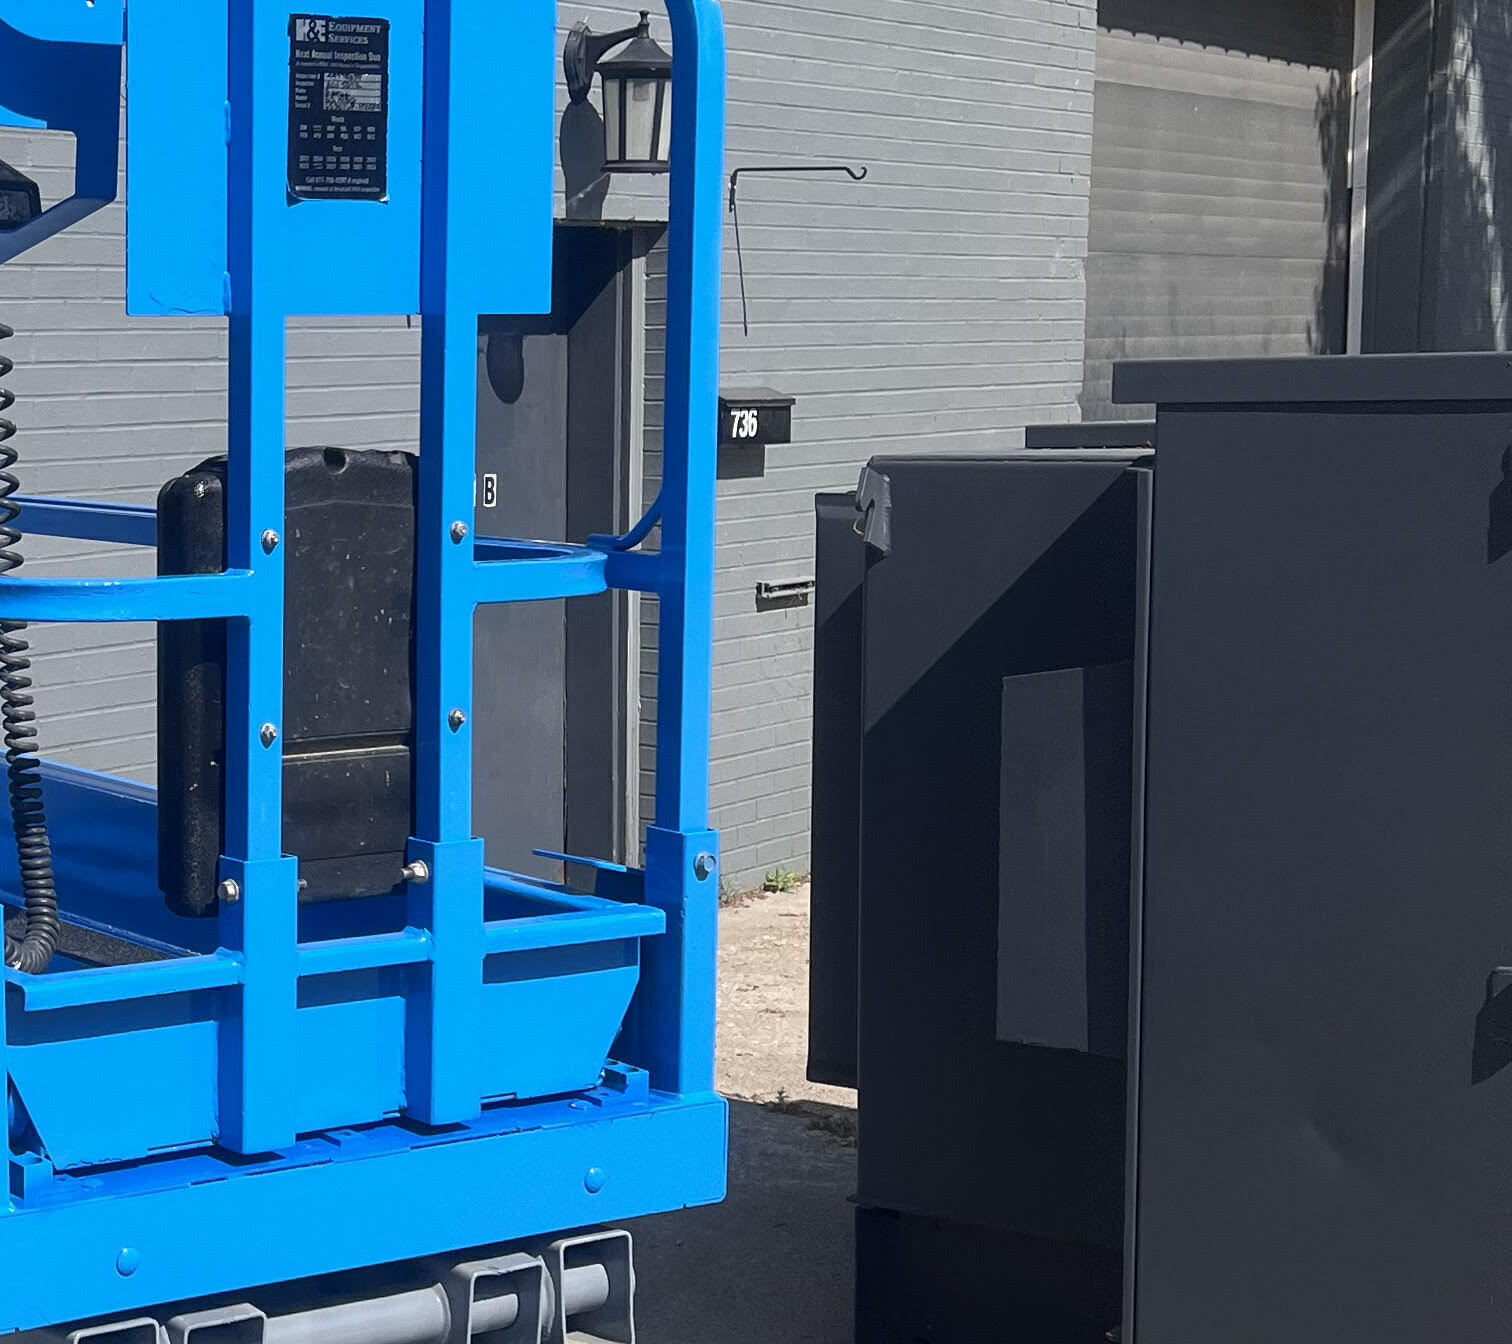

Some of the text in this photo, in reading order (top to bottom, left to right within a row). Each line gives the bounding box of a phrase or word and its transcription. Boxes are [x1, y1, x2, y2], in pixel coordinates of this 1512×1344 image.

[328, 21, 382, 34] EQUIPMENT
[328, 33, 369, 45] SERVICES
[730, 408, 758, 439] 736
[484, 476, 496, 505] B
